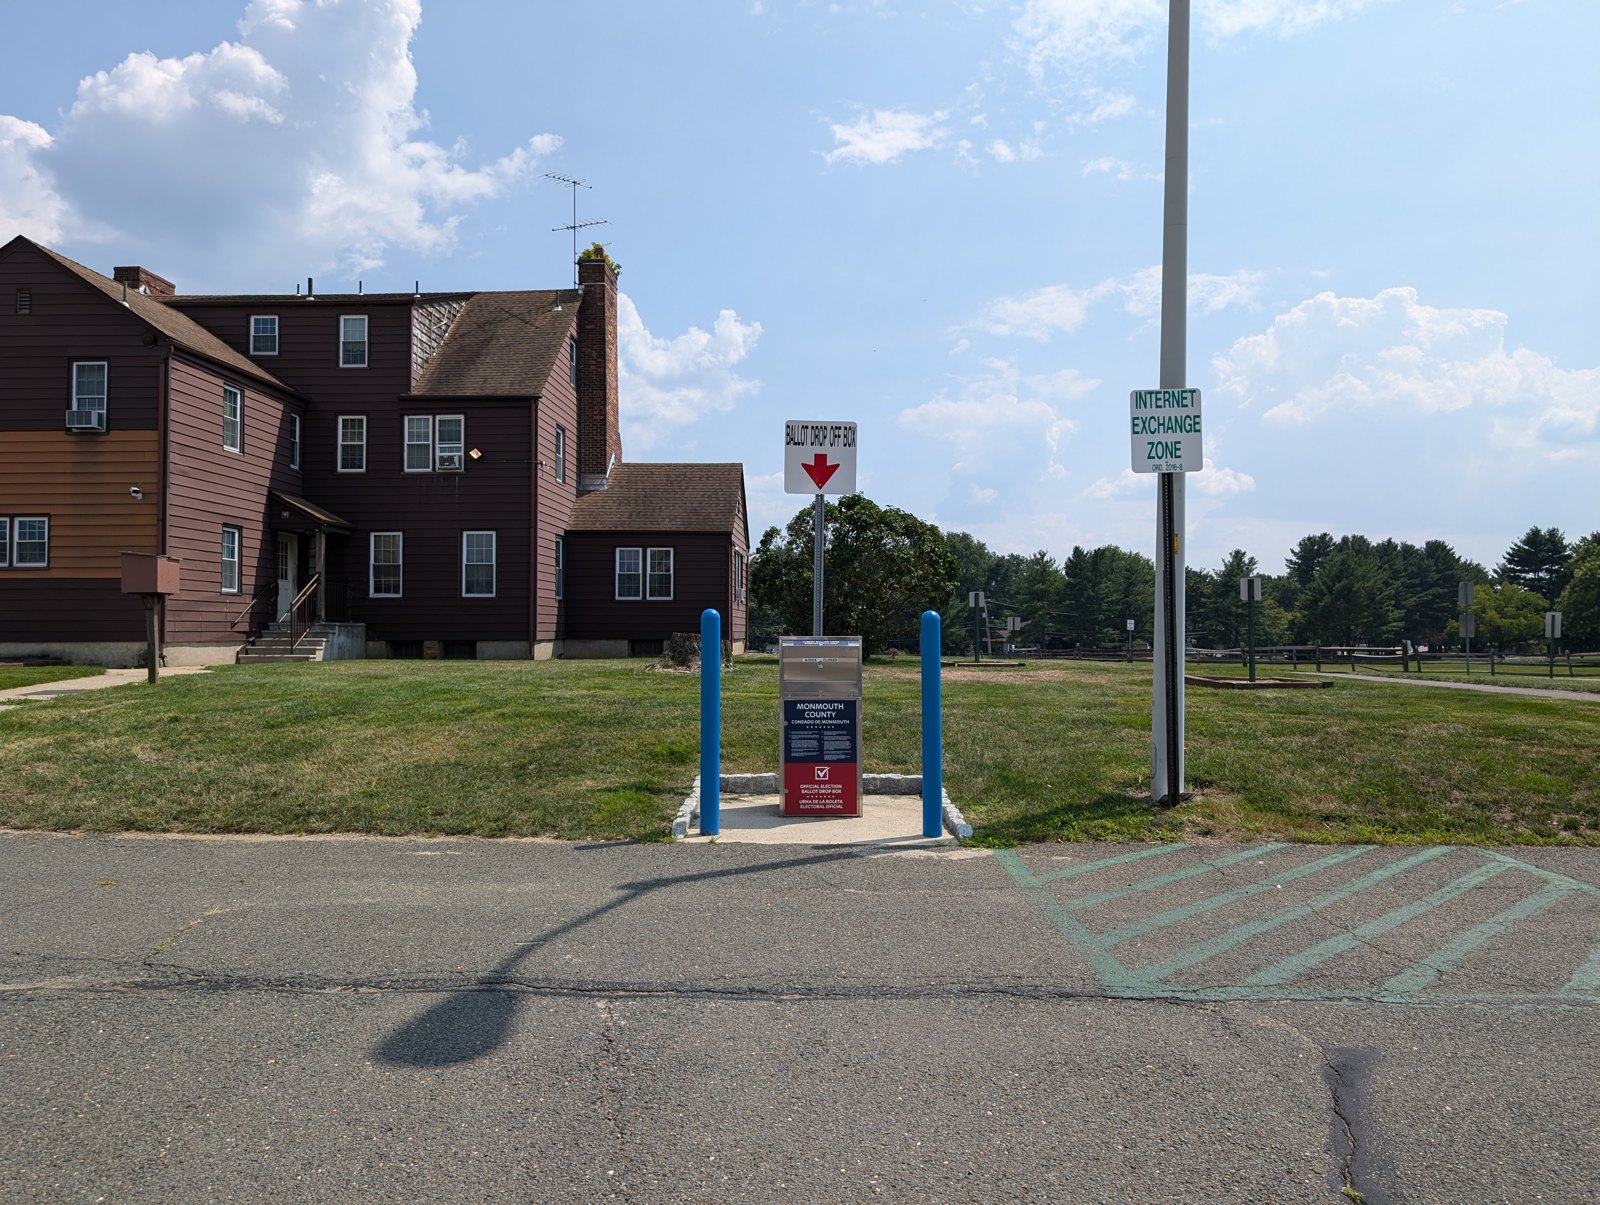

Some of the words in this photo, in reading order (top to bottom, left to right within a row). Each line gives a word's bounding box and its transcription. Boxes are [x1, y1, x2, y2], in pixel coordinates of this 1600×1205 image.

[1135, 390, 1196, 409] INTERNET
[1132, 415, 1201, 434] EXCHANGE
[786, 424, 809, 446] BALLOT
[810, 425, 828, 447] DROP
[829, 425, 842, 447] OFF
[843, 425, 857, 448] BOX
[1147, 441, 1181, 459] ZONE
